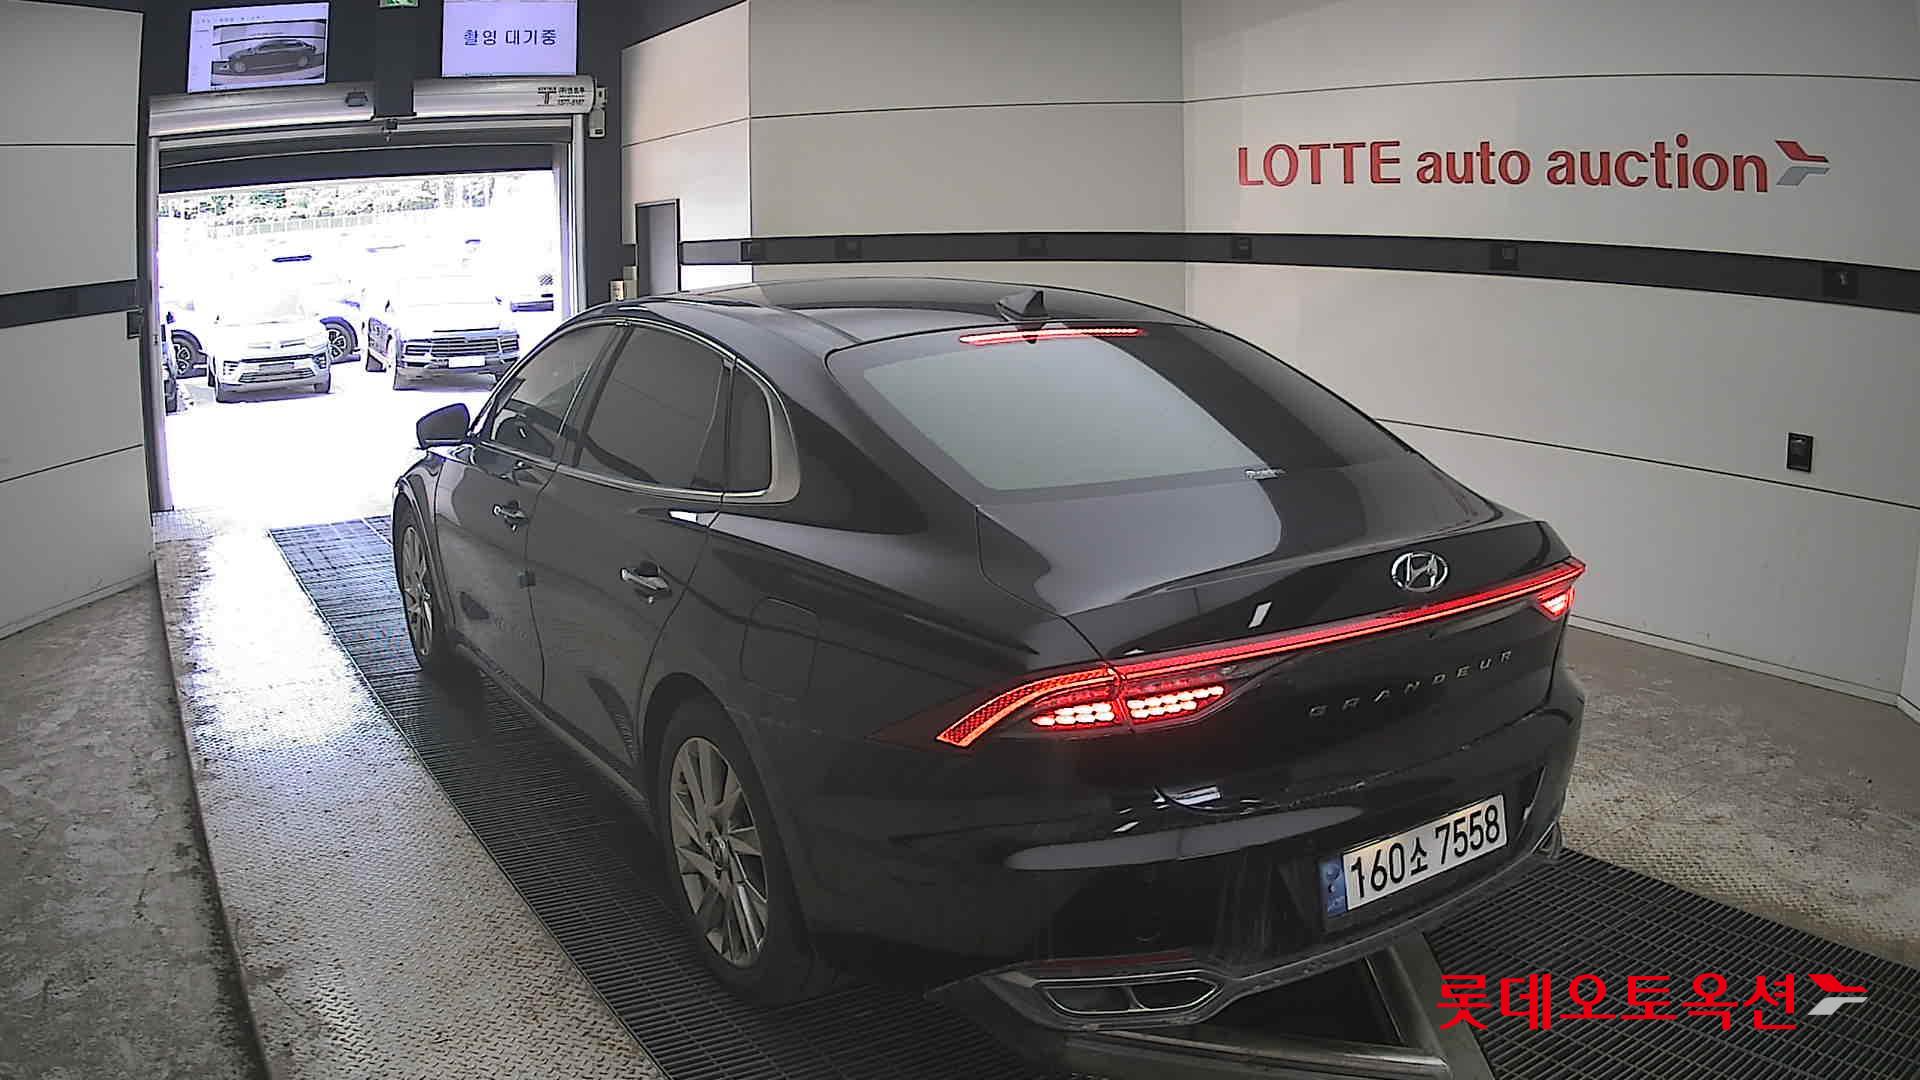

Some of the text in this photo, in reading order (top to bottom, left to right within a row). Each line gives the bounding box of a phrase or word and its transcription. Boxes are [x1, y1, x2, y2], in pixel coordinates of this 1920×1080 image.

[505, 29, 557, 46] 대기중
[1238, 133, 1768, 193] LOTTE auto auction
[1309, 650, 1512, 716] GRANDEUR
[1351, 805, 1500, 898] 160소 7558
